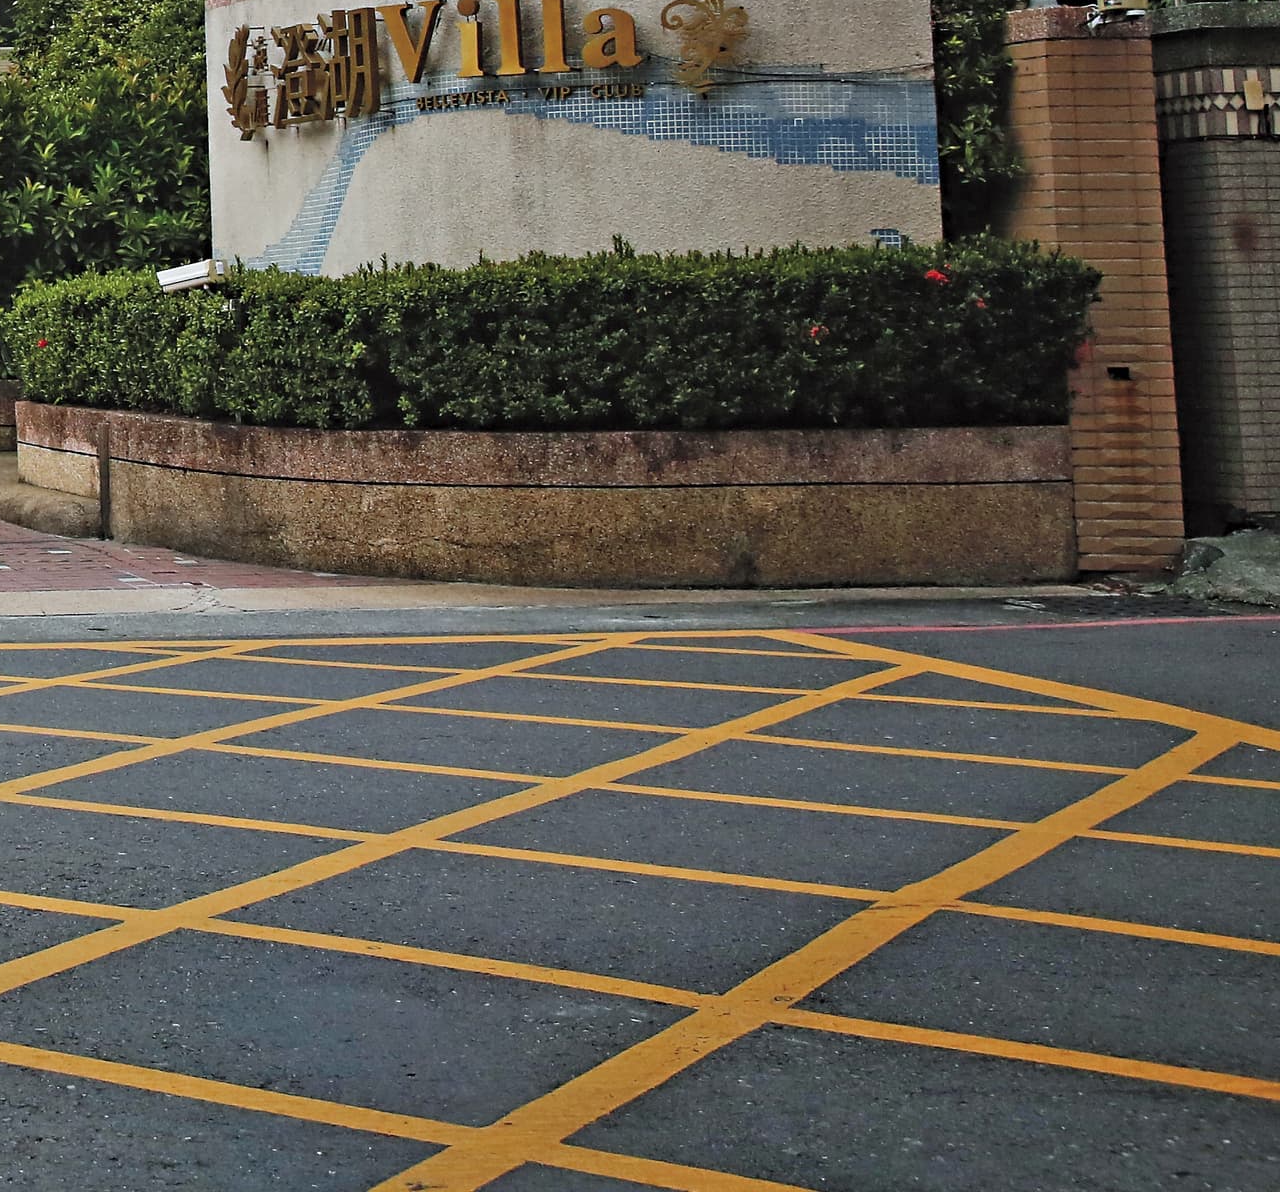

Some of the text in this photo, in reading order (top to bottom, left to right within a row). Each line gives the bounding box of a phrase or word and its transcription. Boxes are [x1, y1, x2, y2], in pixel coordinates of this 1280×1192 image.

[416, 83, 646, 111] BELLEVISTA VIP CLUB
